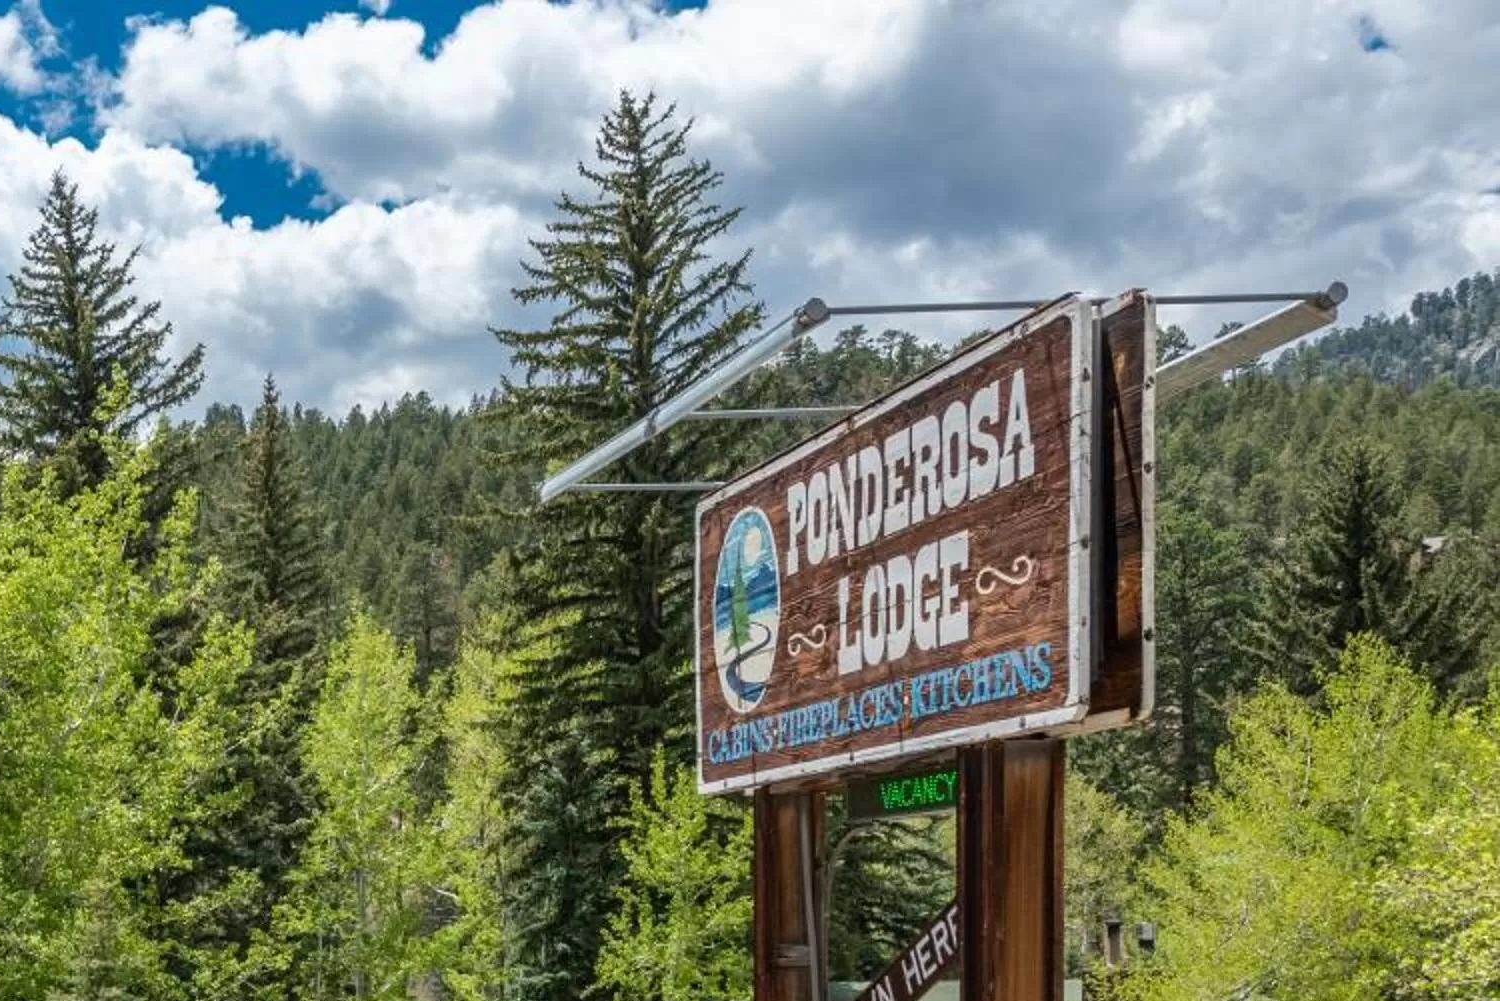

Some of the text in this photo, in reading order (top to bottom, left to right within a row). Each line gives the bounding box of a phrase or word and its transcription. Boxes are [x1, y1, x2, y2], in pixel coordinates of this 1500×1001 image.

[786, 368, 1035, 576] PONDEROSA
[837, 530, 970, 675] LODGE
[707, 641, 1053, 765] CABINS FIREPLACES KITCHENS
[879, 771, 957, 809] VACANCY
